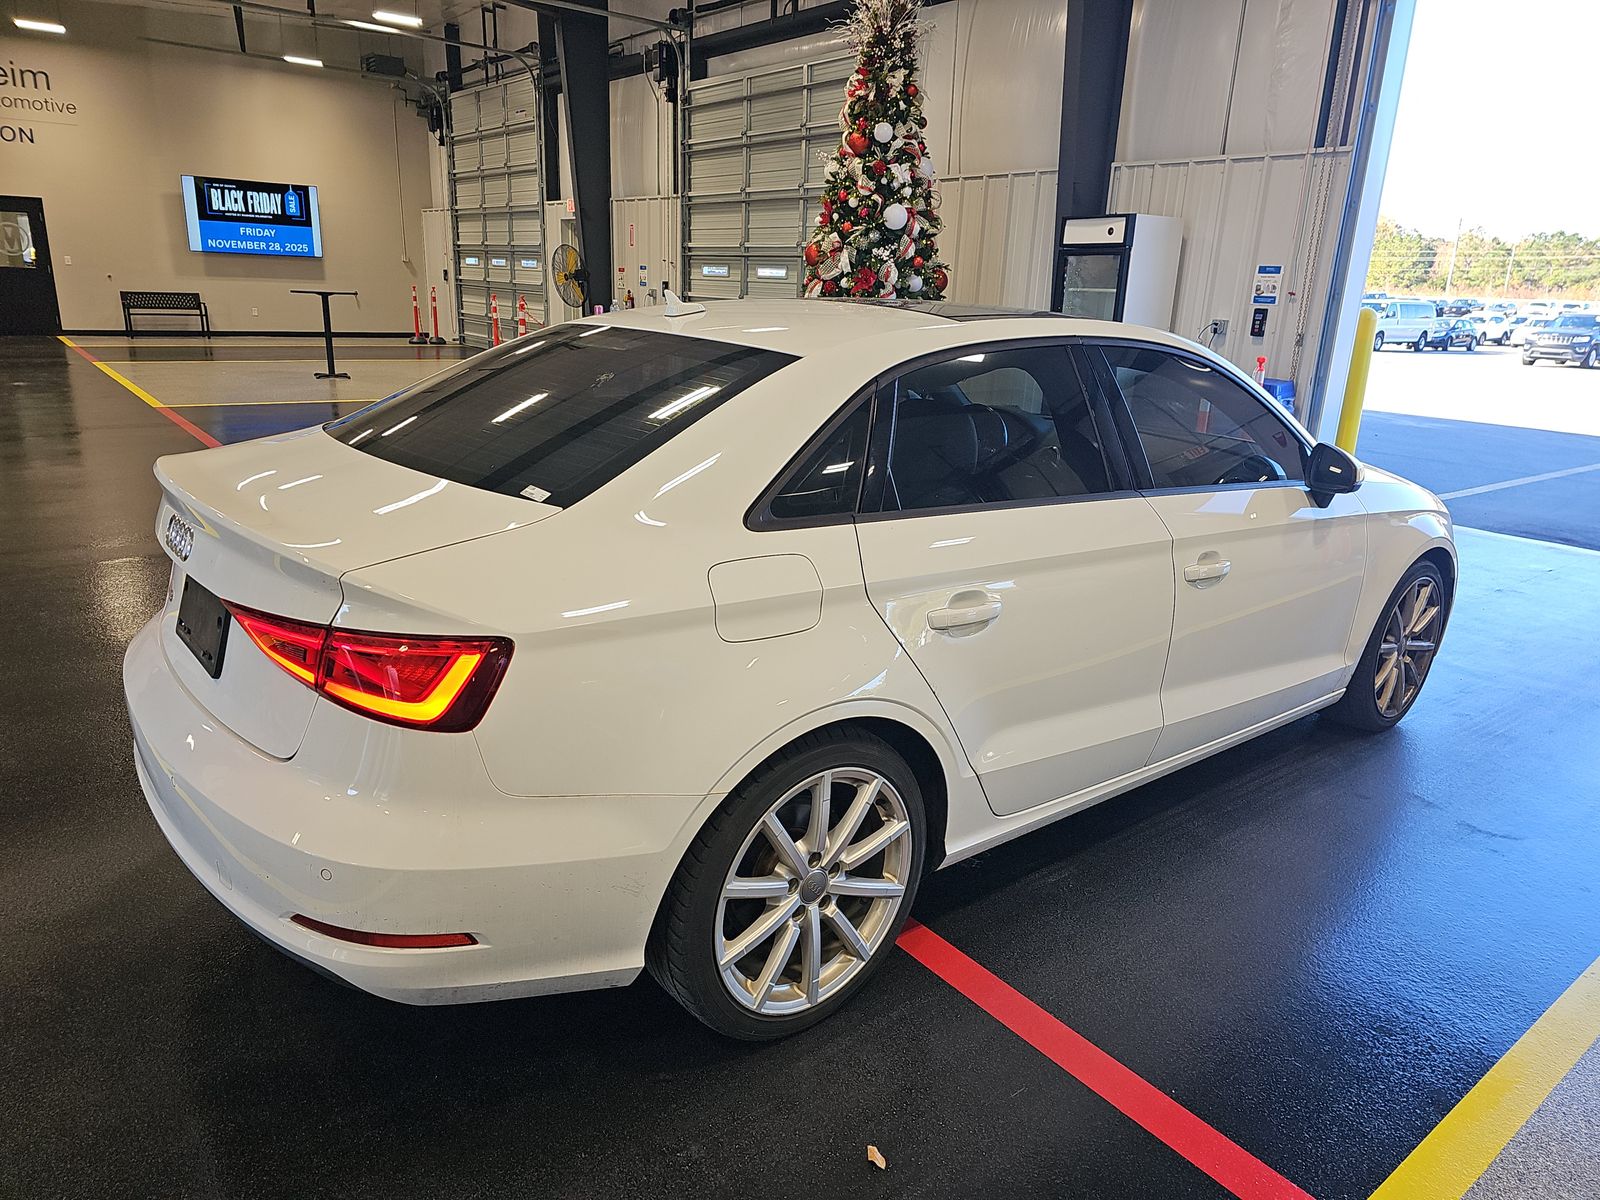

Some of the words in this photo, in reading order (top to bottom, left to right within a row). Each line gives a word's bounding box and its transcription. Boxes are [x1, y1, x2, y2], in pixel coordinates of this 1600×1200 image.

[0, 60, 51, 91] eim
[0, 96, 77, 114] omotive
[0, 125, 35, 144] ON
[210, 188, 246, 213] BLACK
[246, 190, 282, 215] FRIDAY
[240, 227, 276, 238] FRIDAY
[208, 238, 267, 250] NOVEMBER
[268, 242, 283, 252] 28,
[285, 243, 309, 252] 2025
